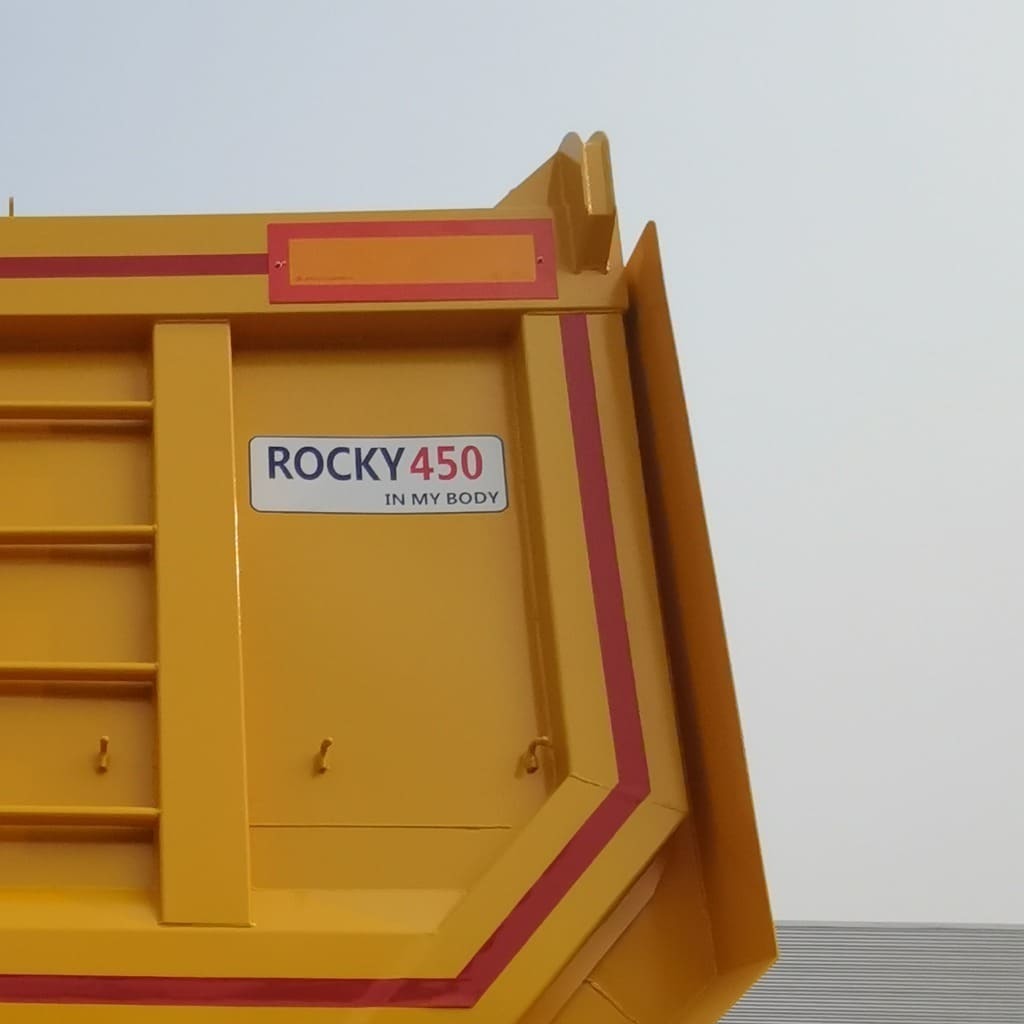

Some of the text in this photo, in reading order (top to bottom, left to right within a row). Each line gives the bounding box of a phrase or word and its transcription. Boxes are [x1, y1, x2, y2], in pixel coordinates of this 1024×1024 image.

[385, 491, 499, 505] IN MY BODY
